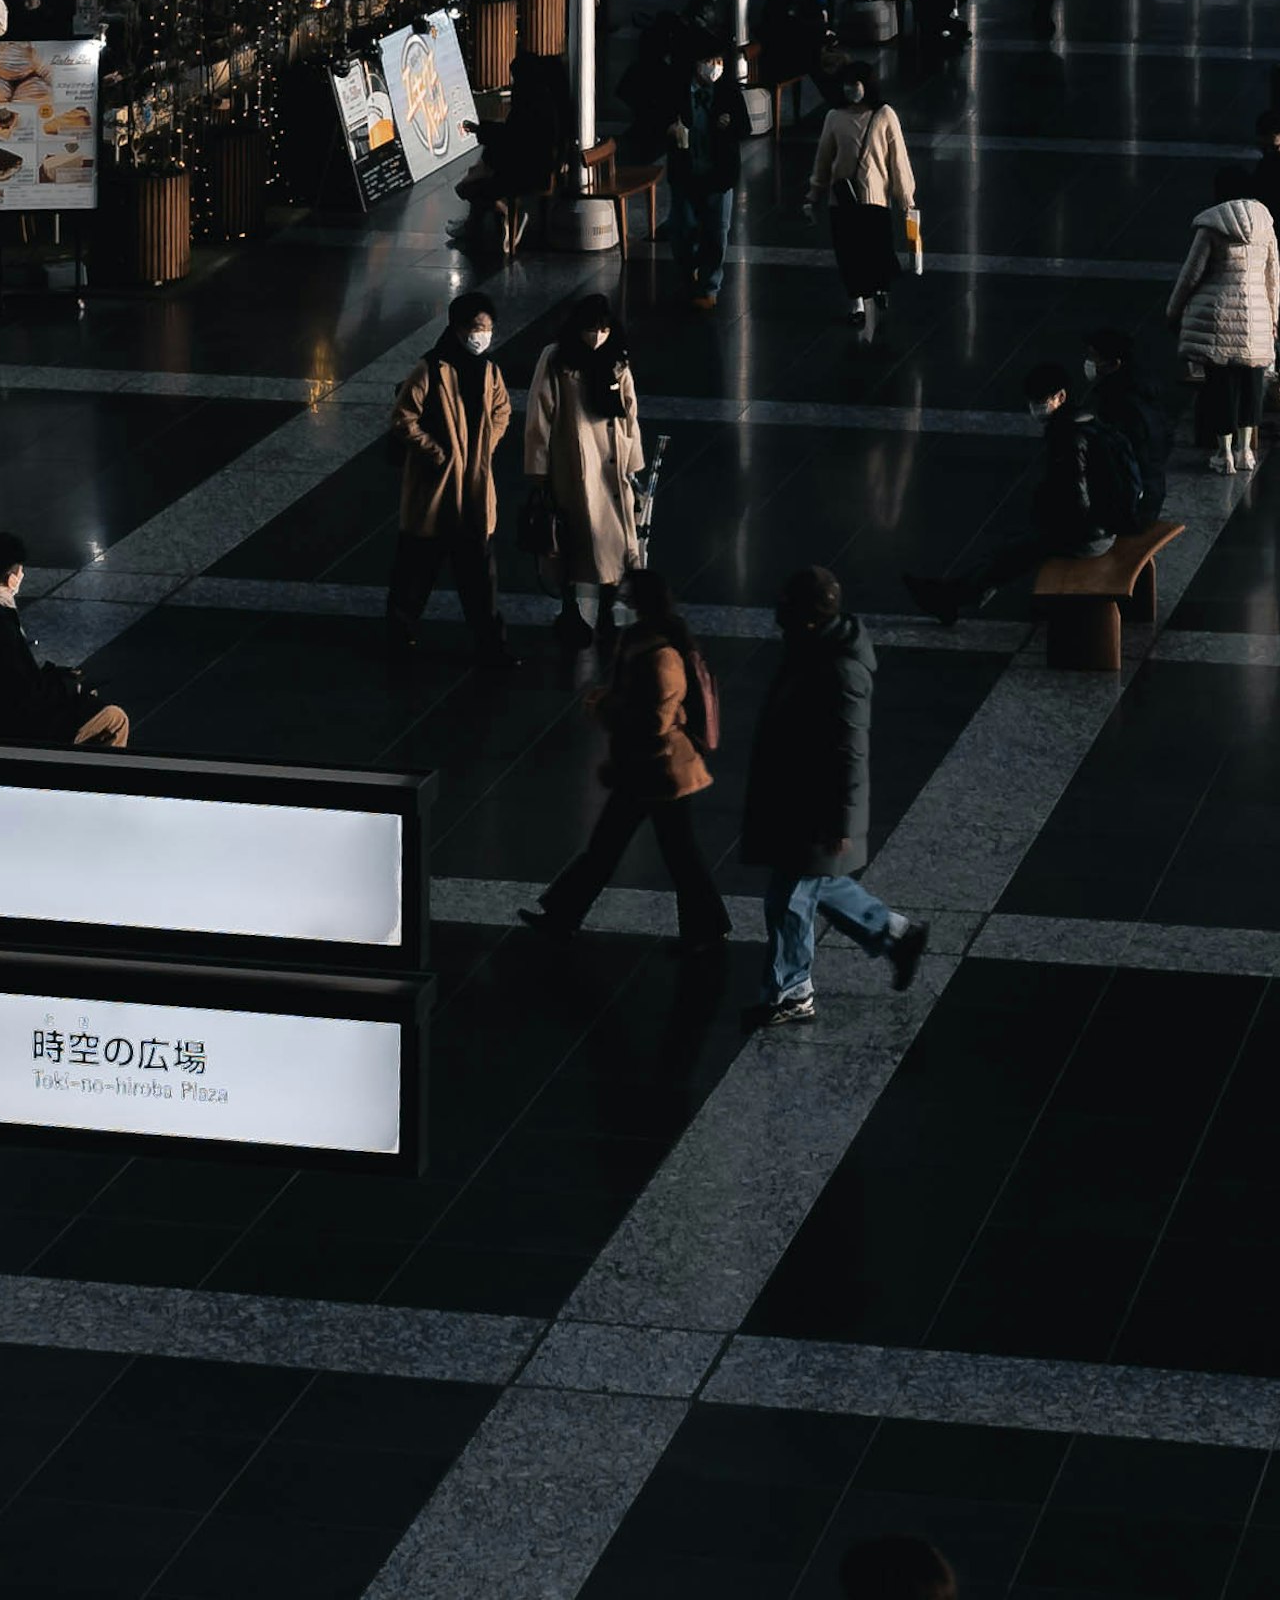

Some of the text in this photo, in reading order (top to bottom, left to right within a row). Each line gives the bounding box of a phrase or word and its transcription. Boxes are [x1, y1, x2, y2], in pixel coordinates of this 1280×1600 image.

[32, 1028, 207, 1075] 時空の広場
[32, 1069, 229, 1104] Toki-no-hiroba Plaza
